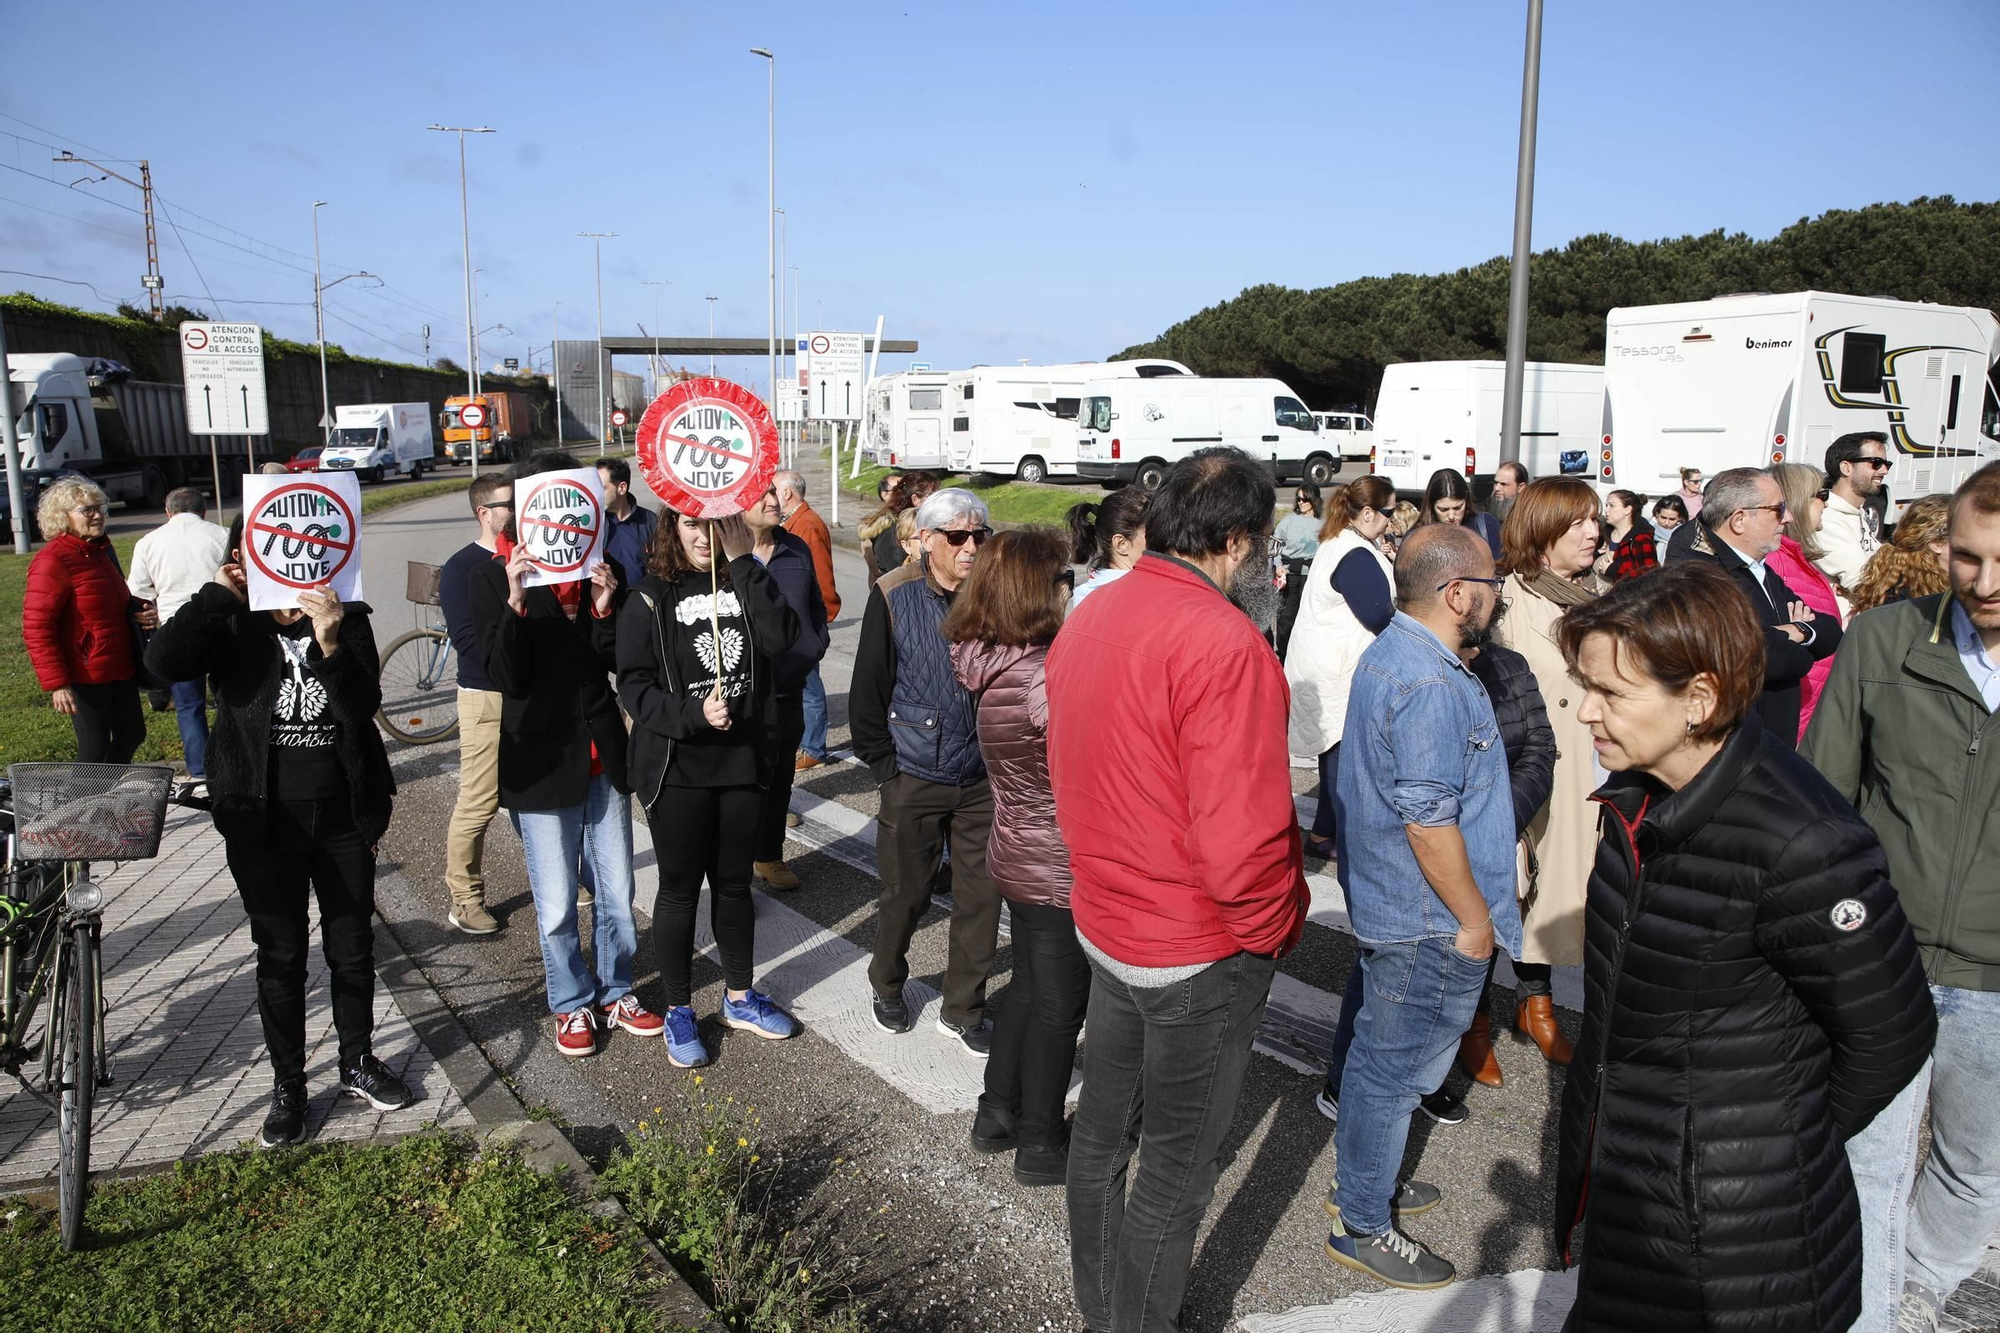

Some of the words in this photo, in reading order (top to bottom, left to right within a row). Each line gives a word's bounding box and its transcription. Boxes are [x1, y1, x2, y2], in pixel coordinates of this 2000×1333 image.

[211, 326, 255, 334] ATENCION
[212, 335, 254, 344] CONTROL
[1745, 337, 1793, 349] benimar
[208, 345, 220, 353] DE
[224, 345, 260, 354] ACCESO
[1613, 345, 1676, 357] Tessoro
[1659, 353, 1684, 363] 495
[684, 471, 734, 489] JOVE
[538, 546, 583, 566] JOVE
[276, 560, 330, 581] JOVE
